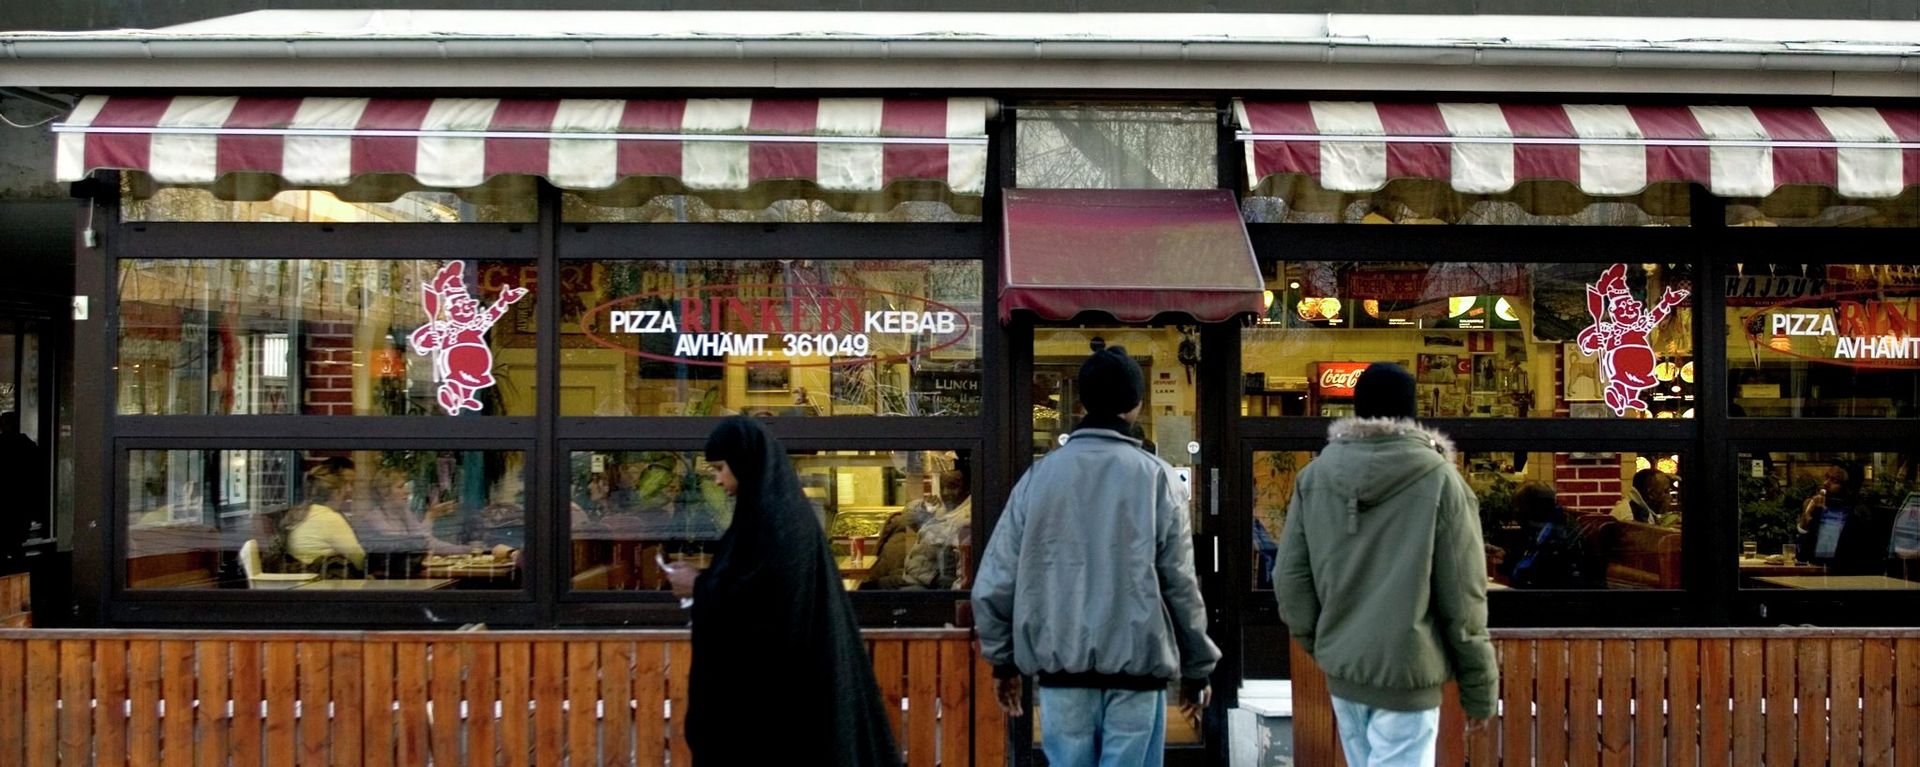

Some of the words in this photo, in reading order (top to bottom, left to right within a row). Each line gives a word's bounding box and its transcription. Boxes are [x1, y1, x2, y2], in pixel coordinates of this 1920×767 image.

[1725, 276, 1825, 297] HAJDUK
[611, 311, 677, 333] PIZZA
[681, 297, 866, 333] RINKEBY
[865, 311, 955, 333] KEBAB
[1772, 314, 1836, 336] PIZZA
[675, 332, 772, 357] AVHÄMT.
[783, 333, 869, 357] 361049
[1834, 335, 1920, 359] AVHÄMT
[935, 378, 978, 391] LUNCH
[1320, 368, 1365, 389] Coca-Co
